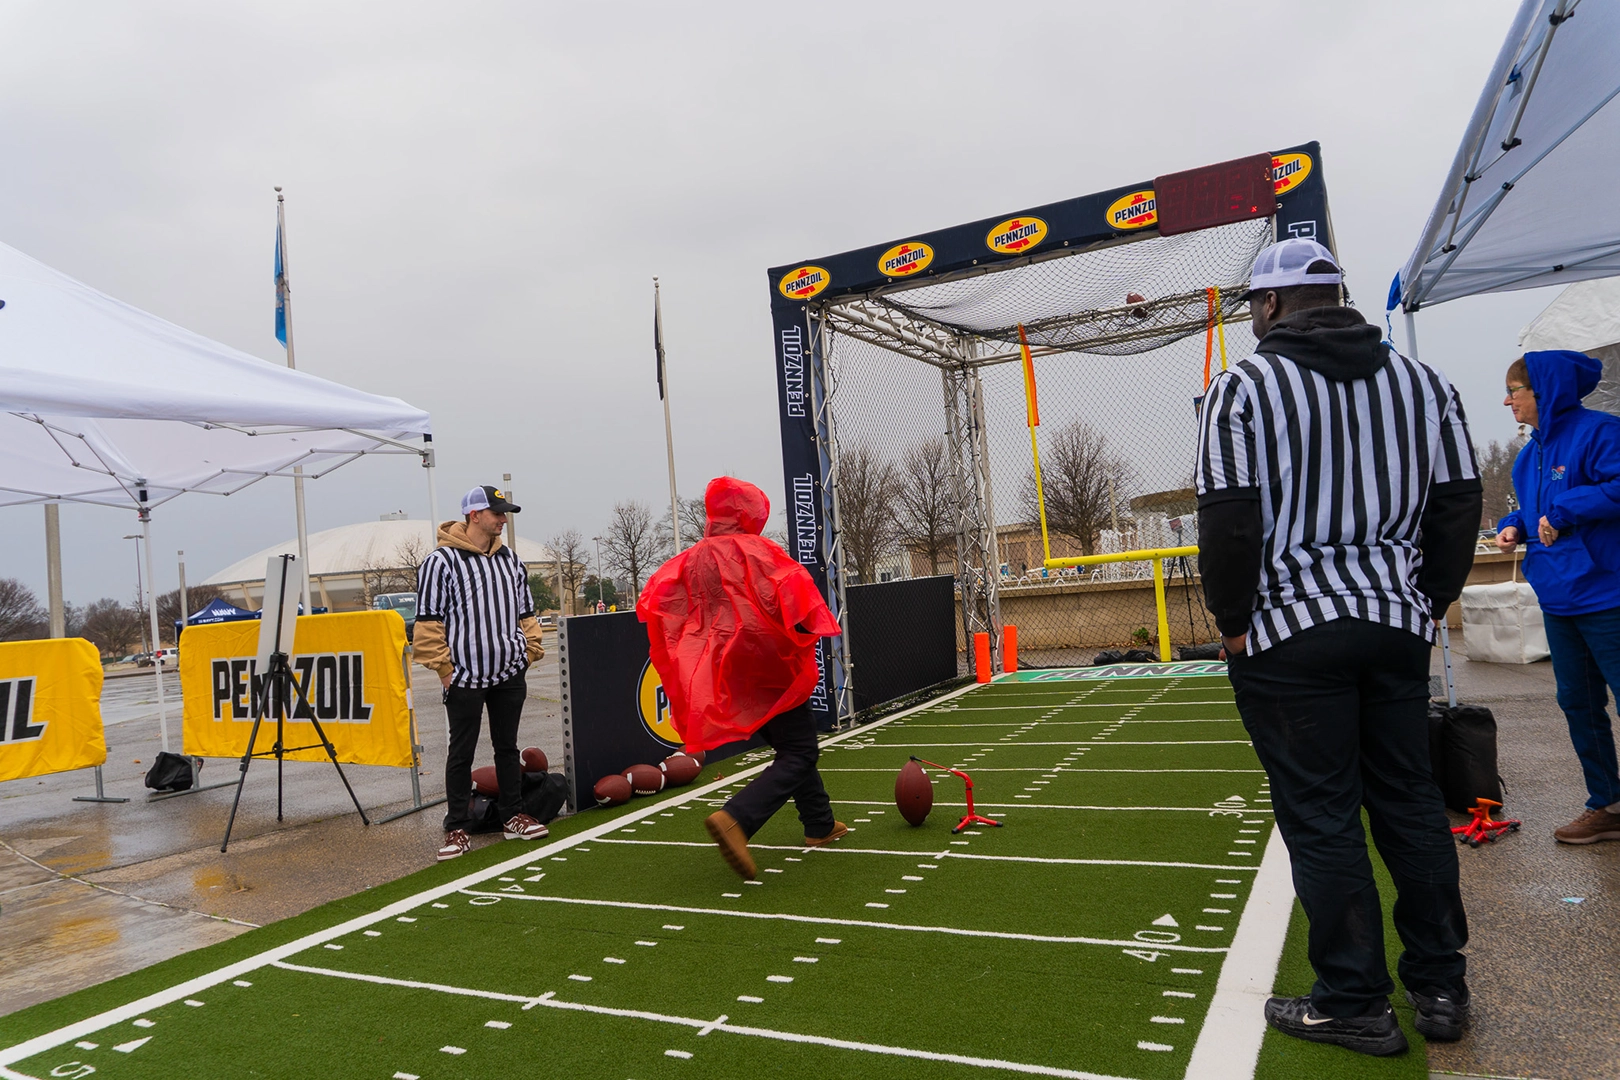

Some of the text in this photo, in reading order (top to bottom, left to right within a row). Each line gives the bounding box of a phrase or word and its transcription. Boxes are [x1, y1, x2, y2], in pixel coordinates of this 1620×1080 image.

[994, 222, 1039, 248] PENNZOIL
[1287, 220, 1317, 242] P
[885, 248, 926, 271] PENNZOIL
[785, 272, 823, 293] PENNZOIL
[782, 325, 806, 417] PENNZOIL
[793, 473, 817, 565] PENNZOIL
[655, 684, 673, 725] P
[1208, 801, 1247, 819] 30
[468, 884, 525, 906] 40
[1121, 930, 1181, 962] 40
